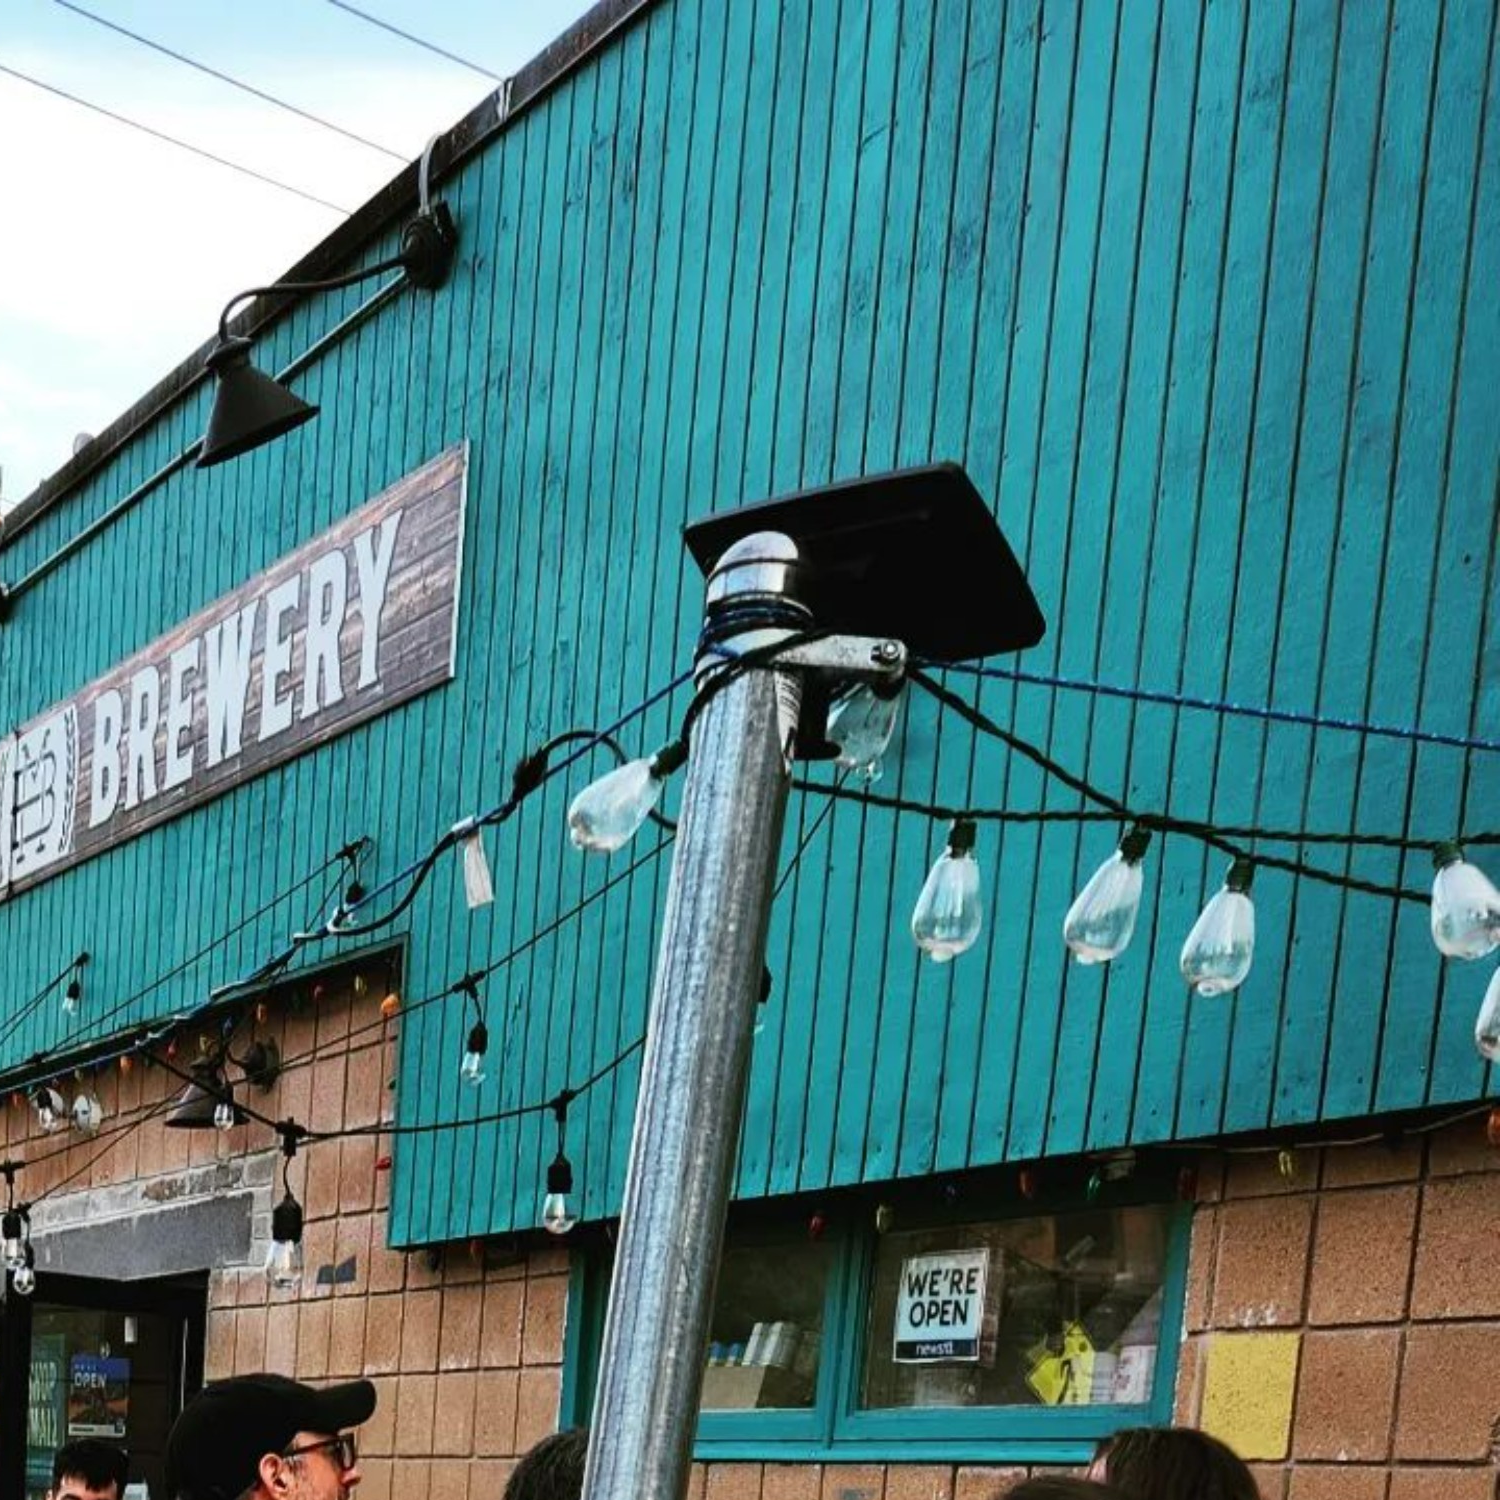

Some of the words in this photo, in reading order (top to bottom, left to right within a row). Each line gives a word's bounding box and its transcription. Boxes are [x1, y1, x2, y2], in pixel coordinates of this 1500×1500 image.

[88, 509, 403, 829] BREWERY
[908, 1268, 979, 1298] WE'RE
[909, 1299, 969, 1328] OPEN
[74, 1372, 107, 1388] OPEN
